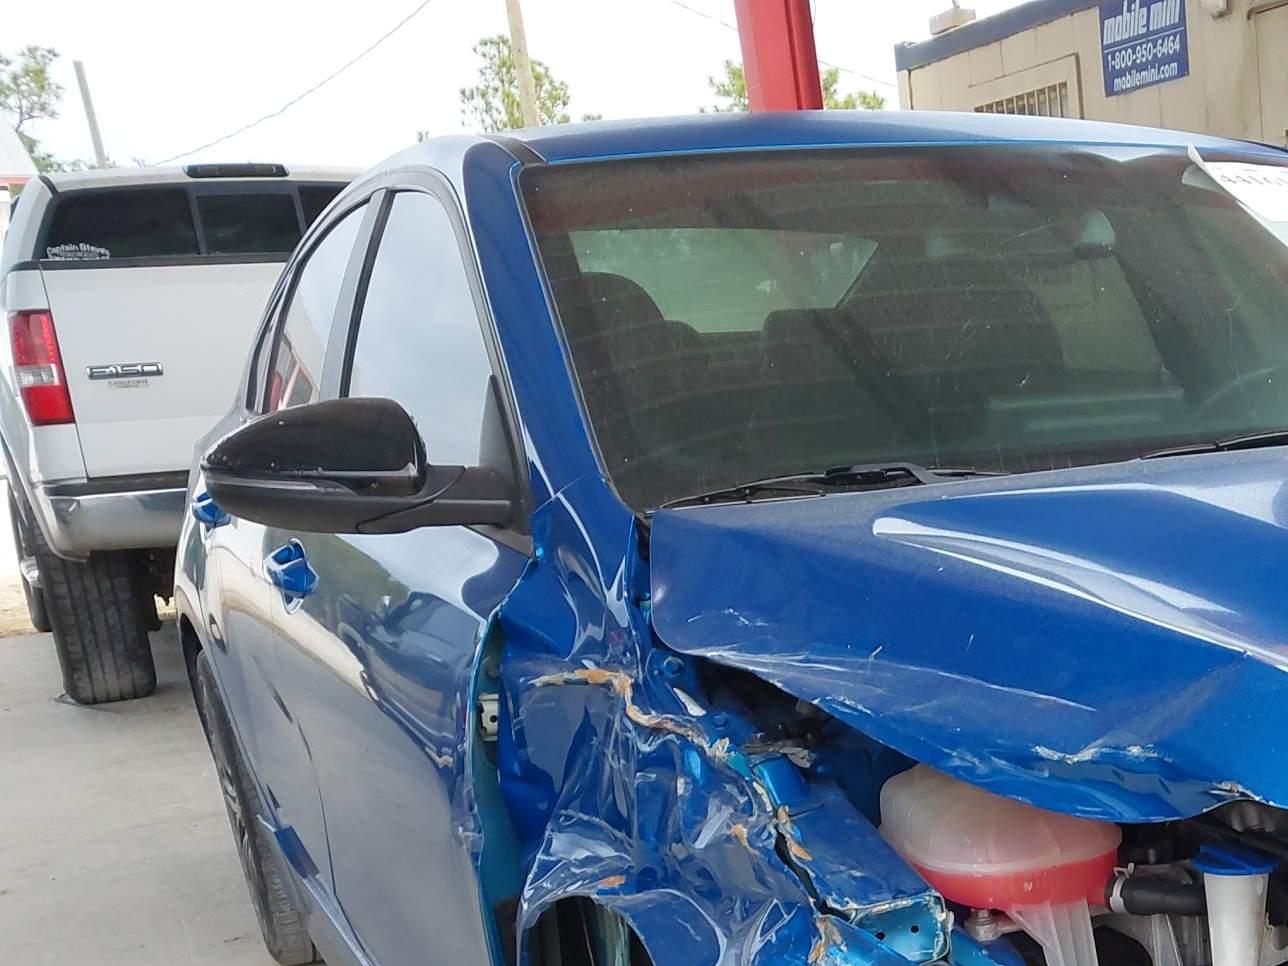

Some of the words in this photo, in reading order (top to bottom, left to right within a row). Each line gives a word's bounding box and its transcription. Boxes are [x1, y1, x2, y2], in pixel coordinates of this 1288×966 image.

[1103, 0, 1147, 45] mobile
[1149, 0, 1180, 31] mini
[1108, 33, 1180, 72] 1-800-950-6464
[1113, 62, 1178, 92] mobilemini.com
